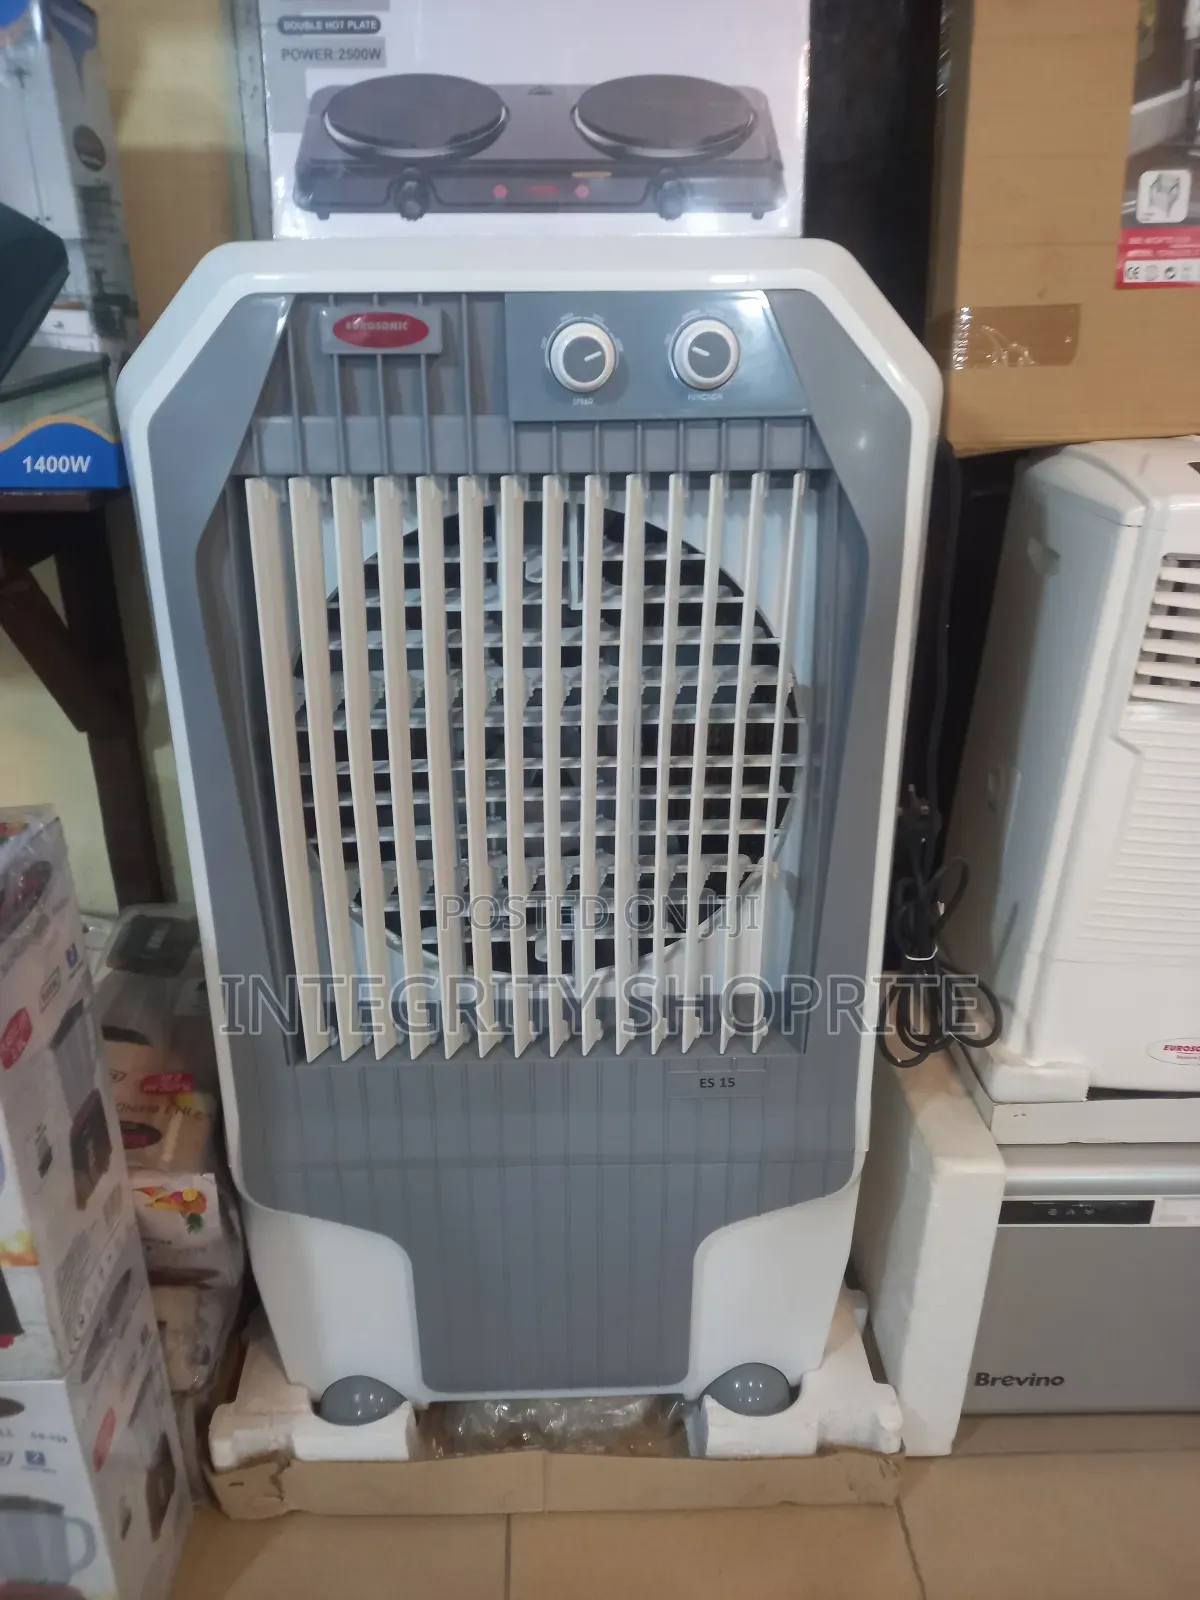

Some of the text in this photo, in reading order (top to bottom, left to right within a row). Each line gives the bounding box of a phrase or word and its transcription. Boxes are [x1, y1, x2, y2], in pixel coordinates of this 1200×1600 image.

[283, 19, 377, 31] DOUBLE HOT PLATE
[22, 455, 92, 474] 1400W
[700, 1077, 736, 1088] ES 15
[975, 1372, 1065, 1387] Brevino
